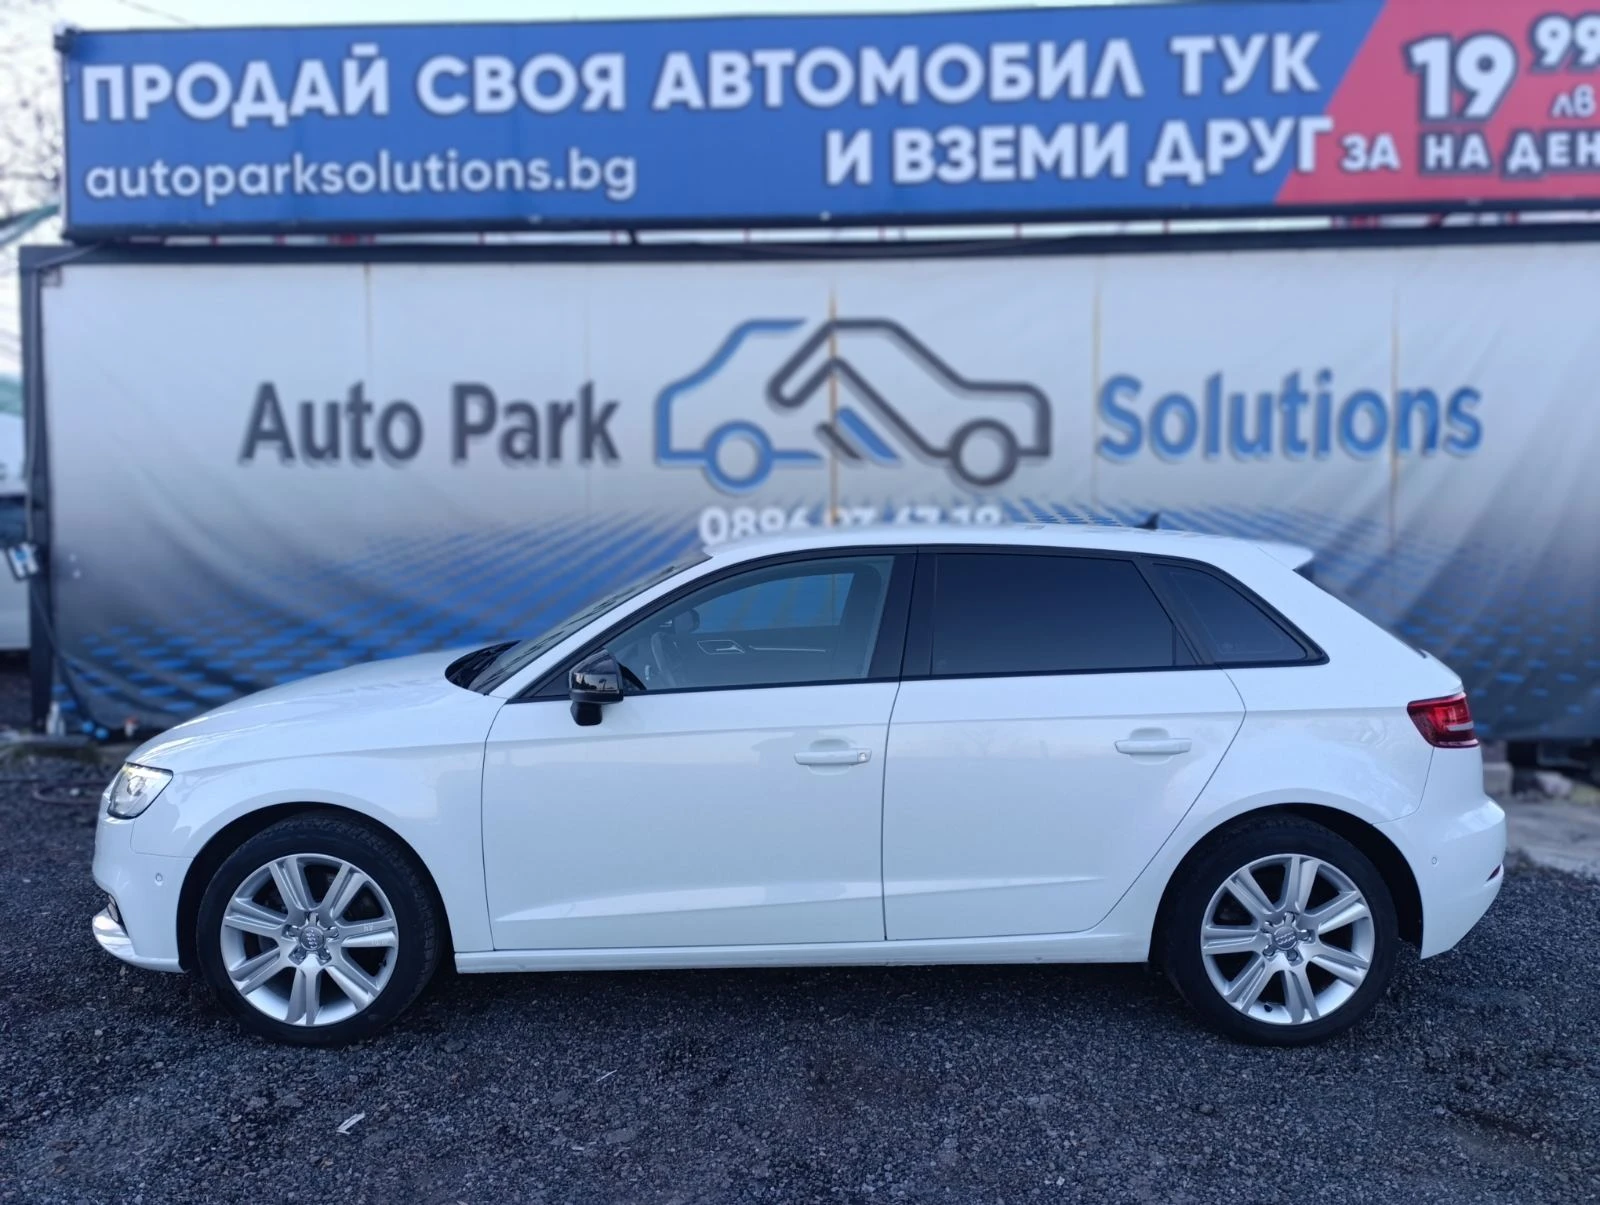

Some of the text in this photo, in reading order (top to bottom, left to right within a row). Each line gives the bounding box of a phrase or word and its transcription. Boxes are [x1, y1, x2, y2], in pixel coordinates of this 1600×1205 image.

[82, 32, 1321, 128] ПРОДАЙ СВОЯ АВТОМОБИЛ ТУК
[1409, 35, 1515, 119] 19
[86, 149, 637, 206] autoparksolutions.bg
[826, 116, 1401, 186] И ВЗЕМИ ДРУГ ЗА
[1425, 131, 1600, 173] НА ДЕН
[238, 369, 1484, 465] Auto Park Solutions
